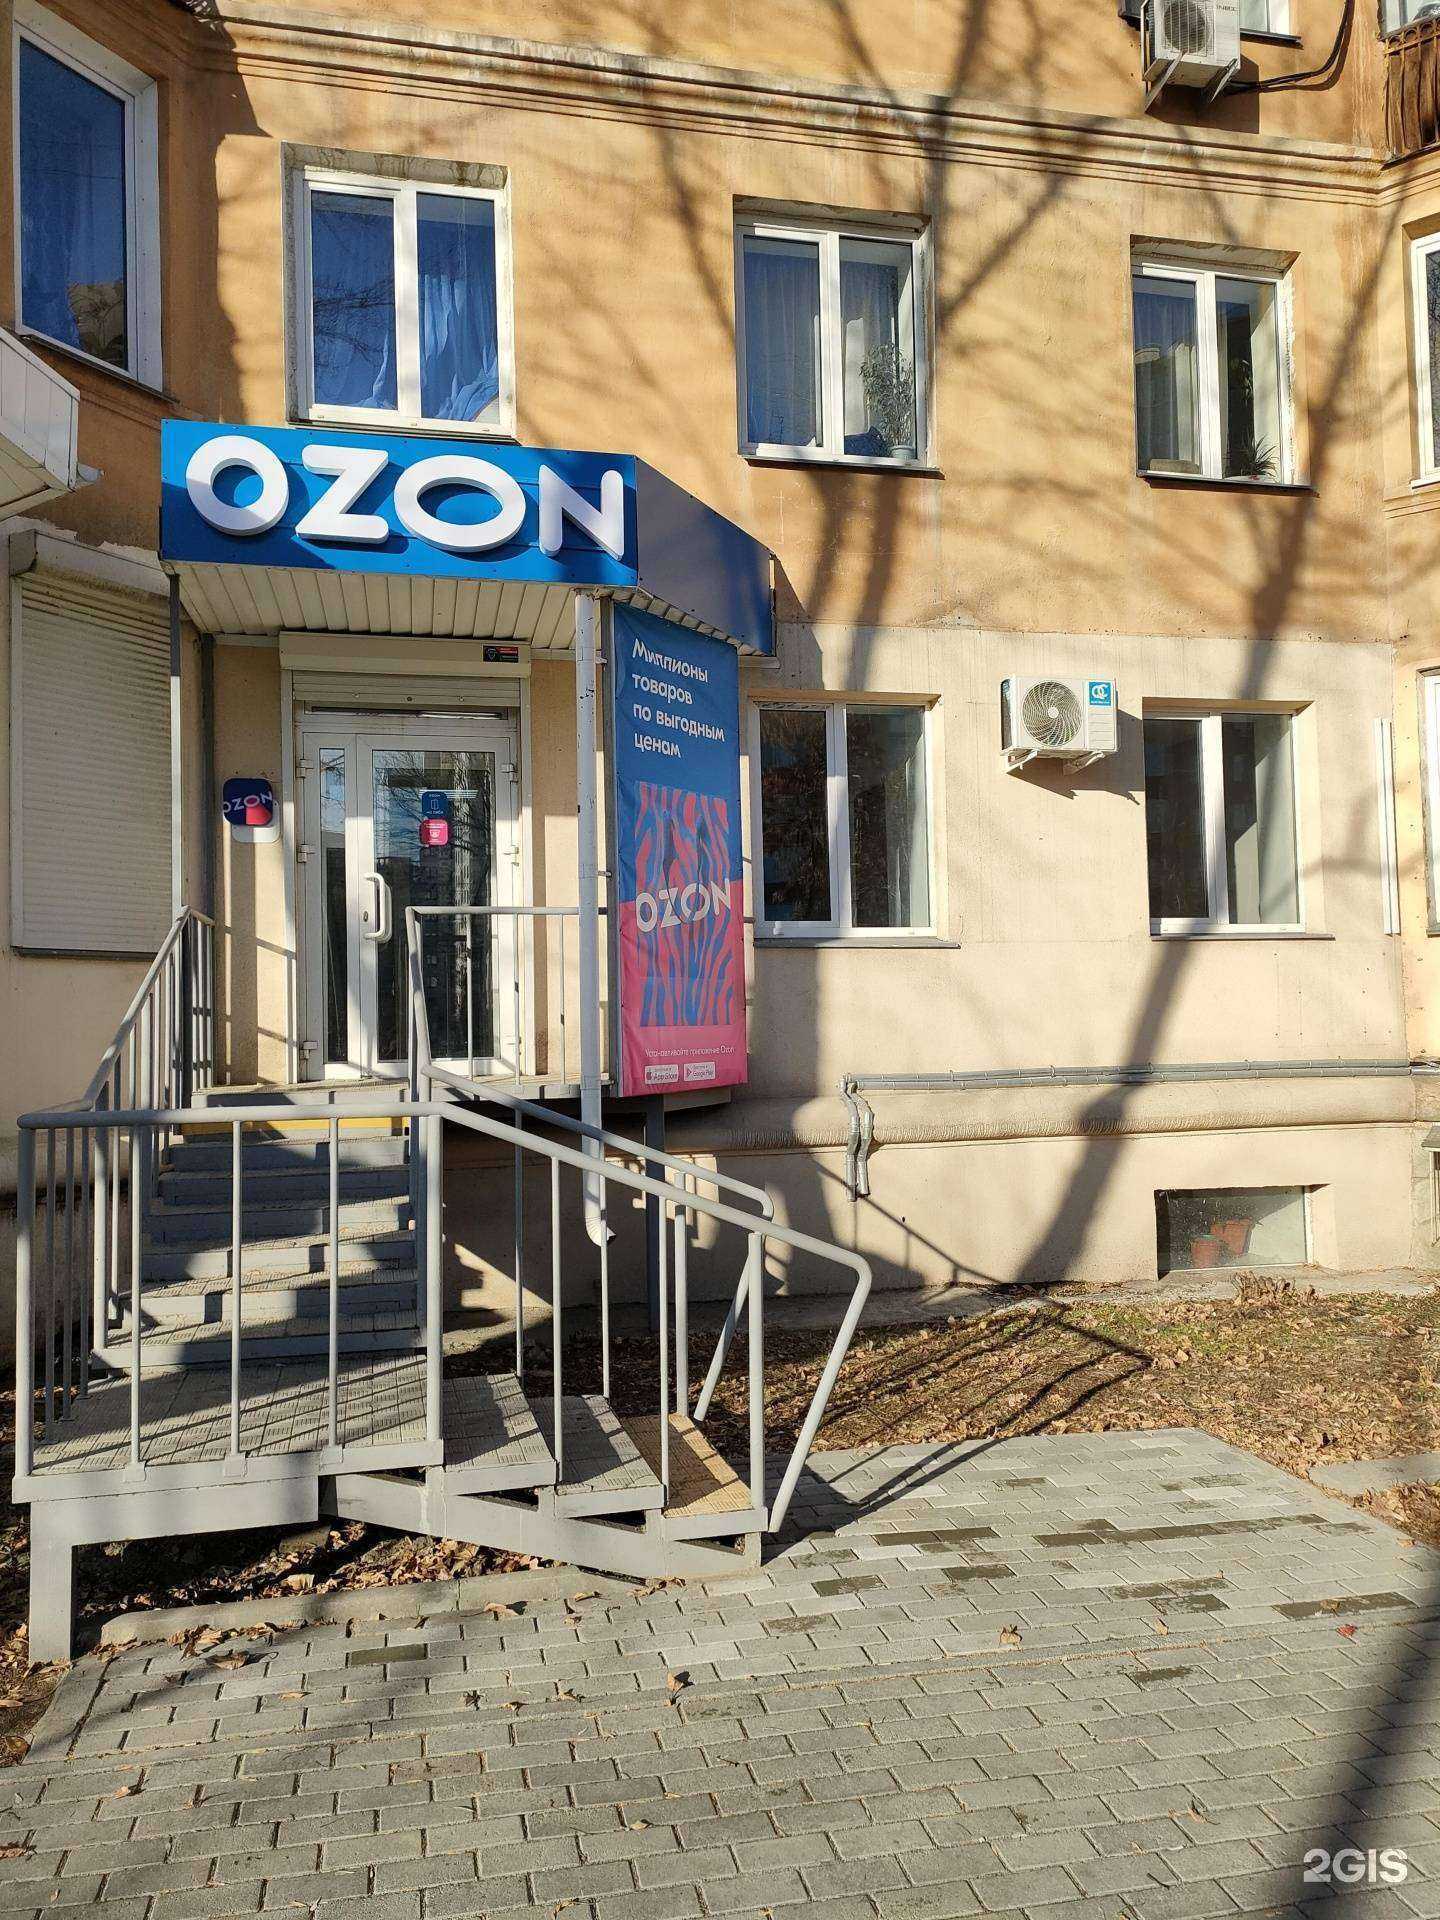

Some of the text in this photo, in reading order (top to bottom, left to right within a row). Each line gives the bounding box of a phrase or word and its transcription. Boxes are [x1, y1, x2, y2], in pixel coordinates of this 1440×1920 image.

[185, 435, 624, 562] OZON
[632, 638, 708, 683] Миллионы
[632, 673, 693, 704] товаров
[633, 703, 725, 742] по выгодным
[634, 732, 681, 758] ценам
[222, 790, 273, 813] OZON
[636, 878, 731, 932] OZON
